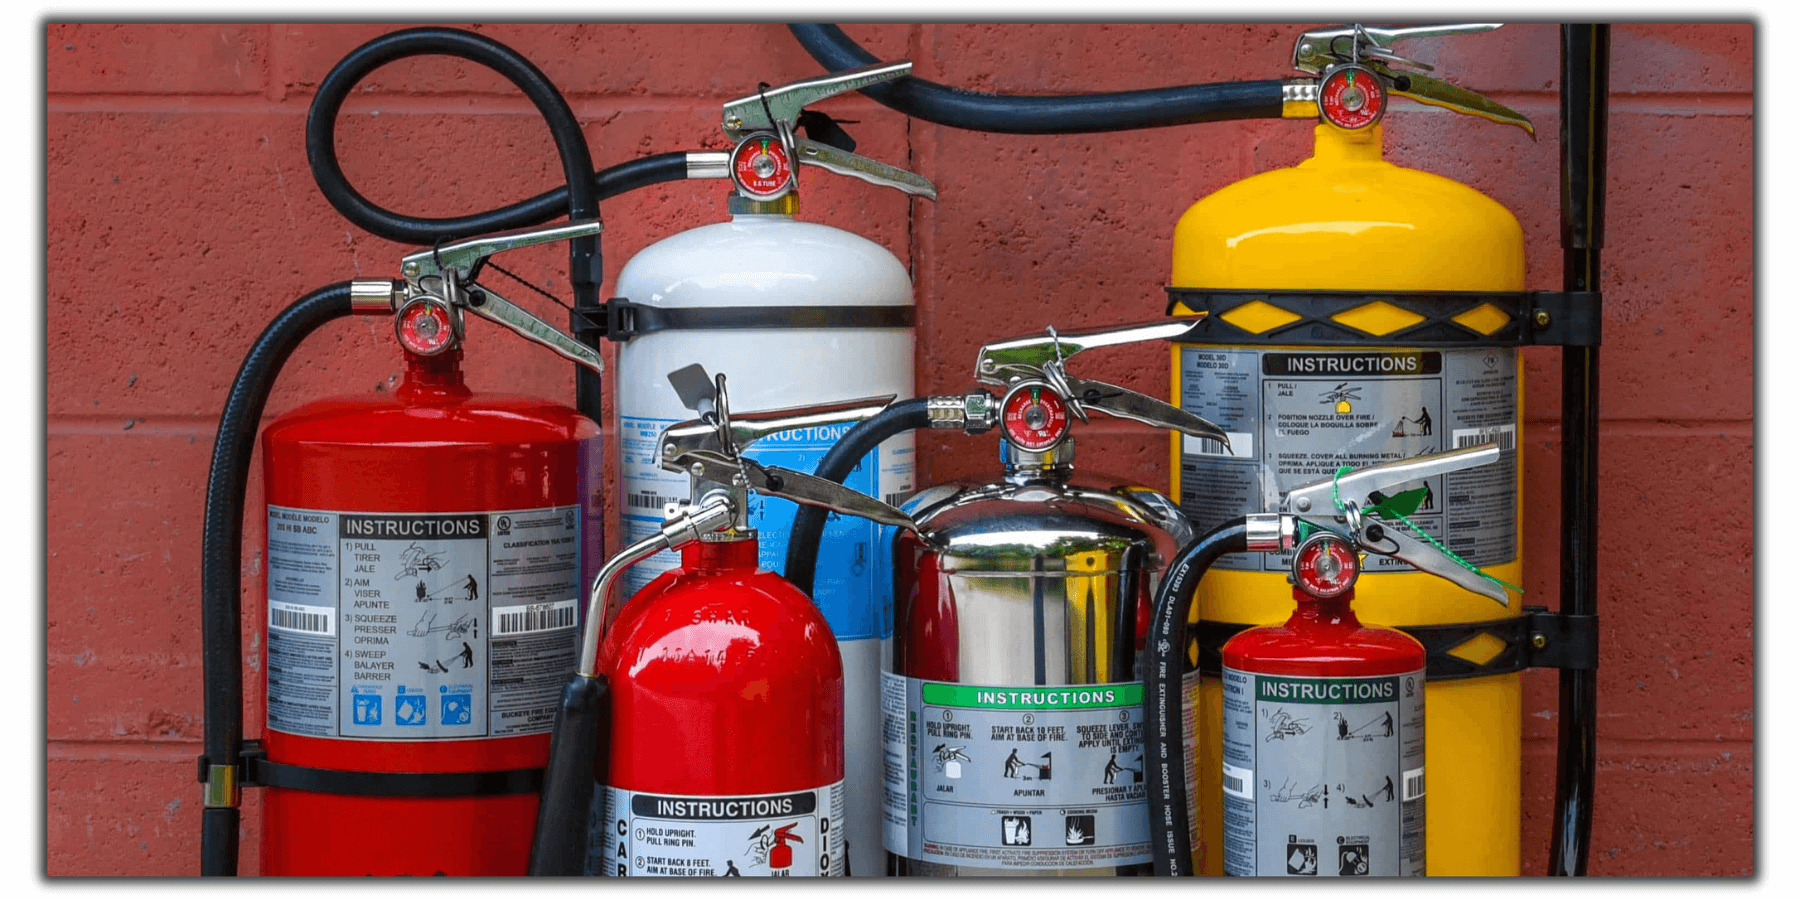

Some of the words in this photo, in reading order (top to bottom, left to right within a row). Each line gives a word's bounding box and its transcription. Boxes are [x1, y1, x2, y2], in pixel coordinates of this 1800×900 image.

[1287, 356, 1417, 372] INSTRUCTIONS
[303, 515, 329, 524] MODELO
[303, 526, 317, 534] ABC
[346, 520, 480, 536] INSTRUCTIONS
[345, 542, 352, 551] 1)
[503, 540, 550, 549] CLASSIFICATION
[345, 579, 352, 588] 2)
[354, 601, 390, 609] APUNTE
[345, 614, 352, 623] 3)
[355, 615, 397, 623] SQUEEZE
[354, 626, 397, 634] PRESSER
[354, 636, 389, 644] OPRIMA
[345, 650, 352, 659] 4)
[354, 661, 394, 669] BALAYER
[1228, 674, 1247, 684] MODELO
[1262, 681, 1393, 699] INSTRUCTIONS
[977, 690, 1114, 705] INSTRUCTIONS
[1262, 708, 1268, 718] 1)
[927, 721, 942, 730] HOLD
[1076, 724, 1107, 734] SQUEEZE
[928, 728, 942, 737] PULL
[943, 730, 958, 738] RING
[960, 731, 973, 740] PIN.
[1082, 732, 1090, 740] TO
[1161, 763, 1170, 800] BOOSTER
[1264, 780, 1272, 790] 3)
[936, 785, 954, 793] JALAR
[1092, 787, 1127, 796] PRESIONAR
[1336, 783, 1346, 793] 4)
[1126, 792, 1146, 800] VACIAR
[657, 798, 793, 817] INSTRUCTIONS
[1164, 805, 1172, 826] HOSE
[646, 827, 663, 836] HOLD
[664, 829, 696, 838] UPRIGHT.
[646, 837, 662, 846] PULL
[664, 838, 680, 847] RING
[682, 839, 696, 848] PIN.
[1167, 831, 1175, 854] ISSUE
[647, 856, 666, 865] START
[668, 858, 685, 866] BACK
[693, 859, 711, 868] FEET.
[647, 866, 658, 874] AIM
[669, 868, 686, 876] BASE
[688, 868, 697, 876] OF
